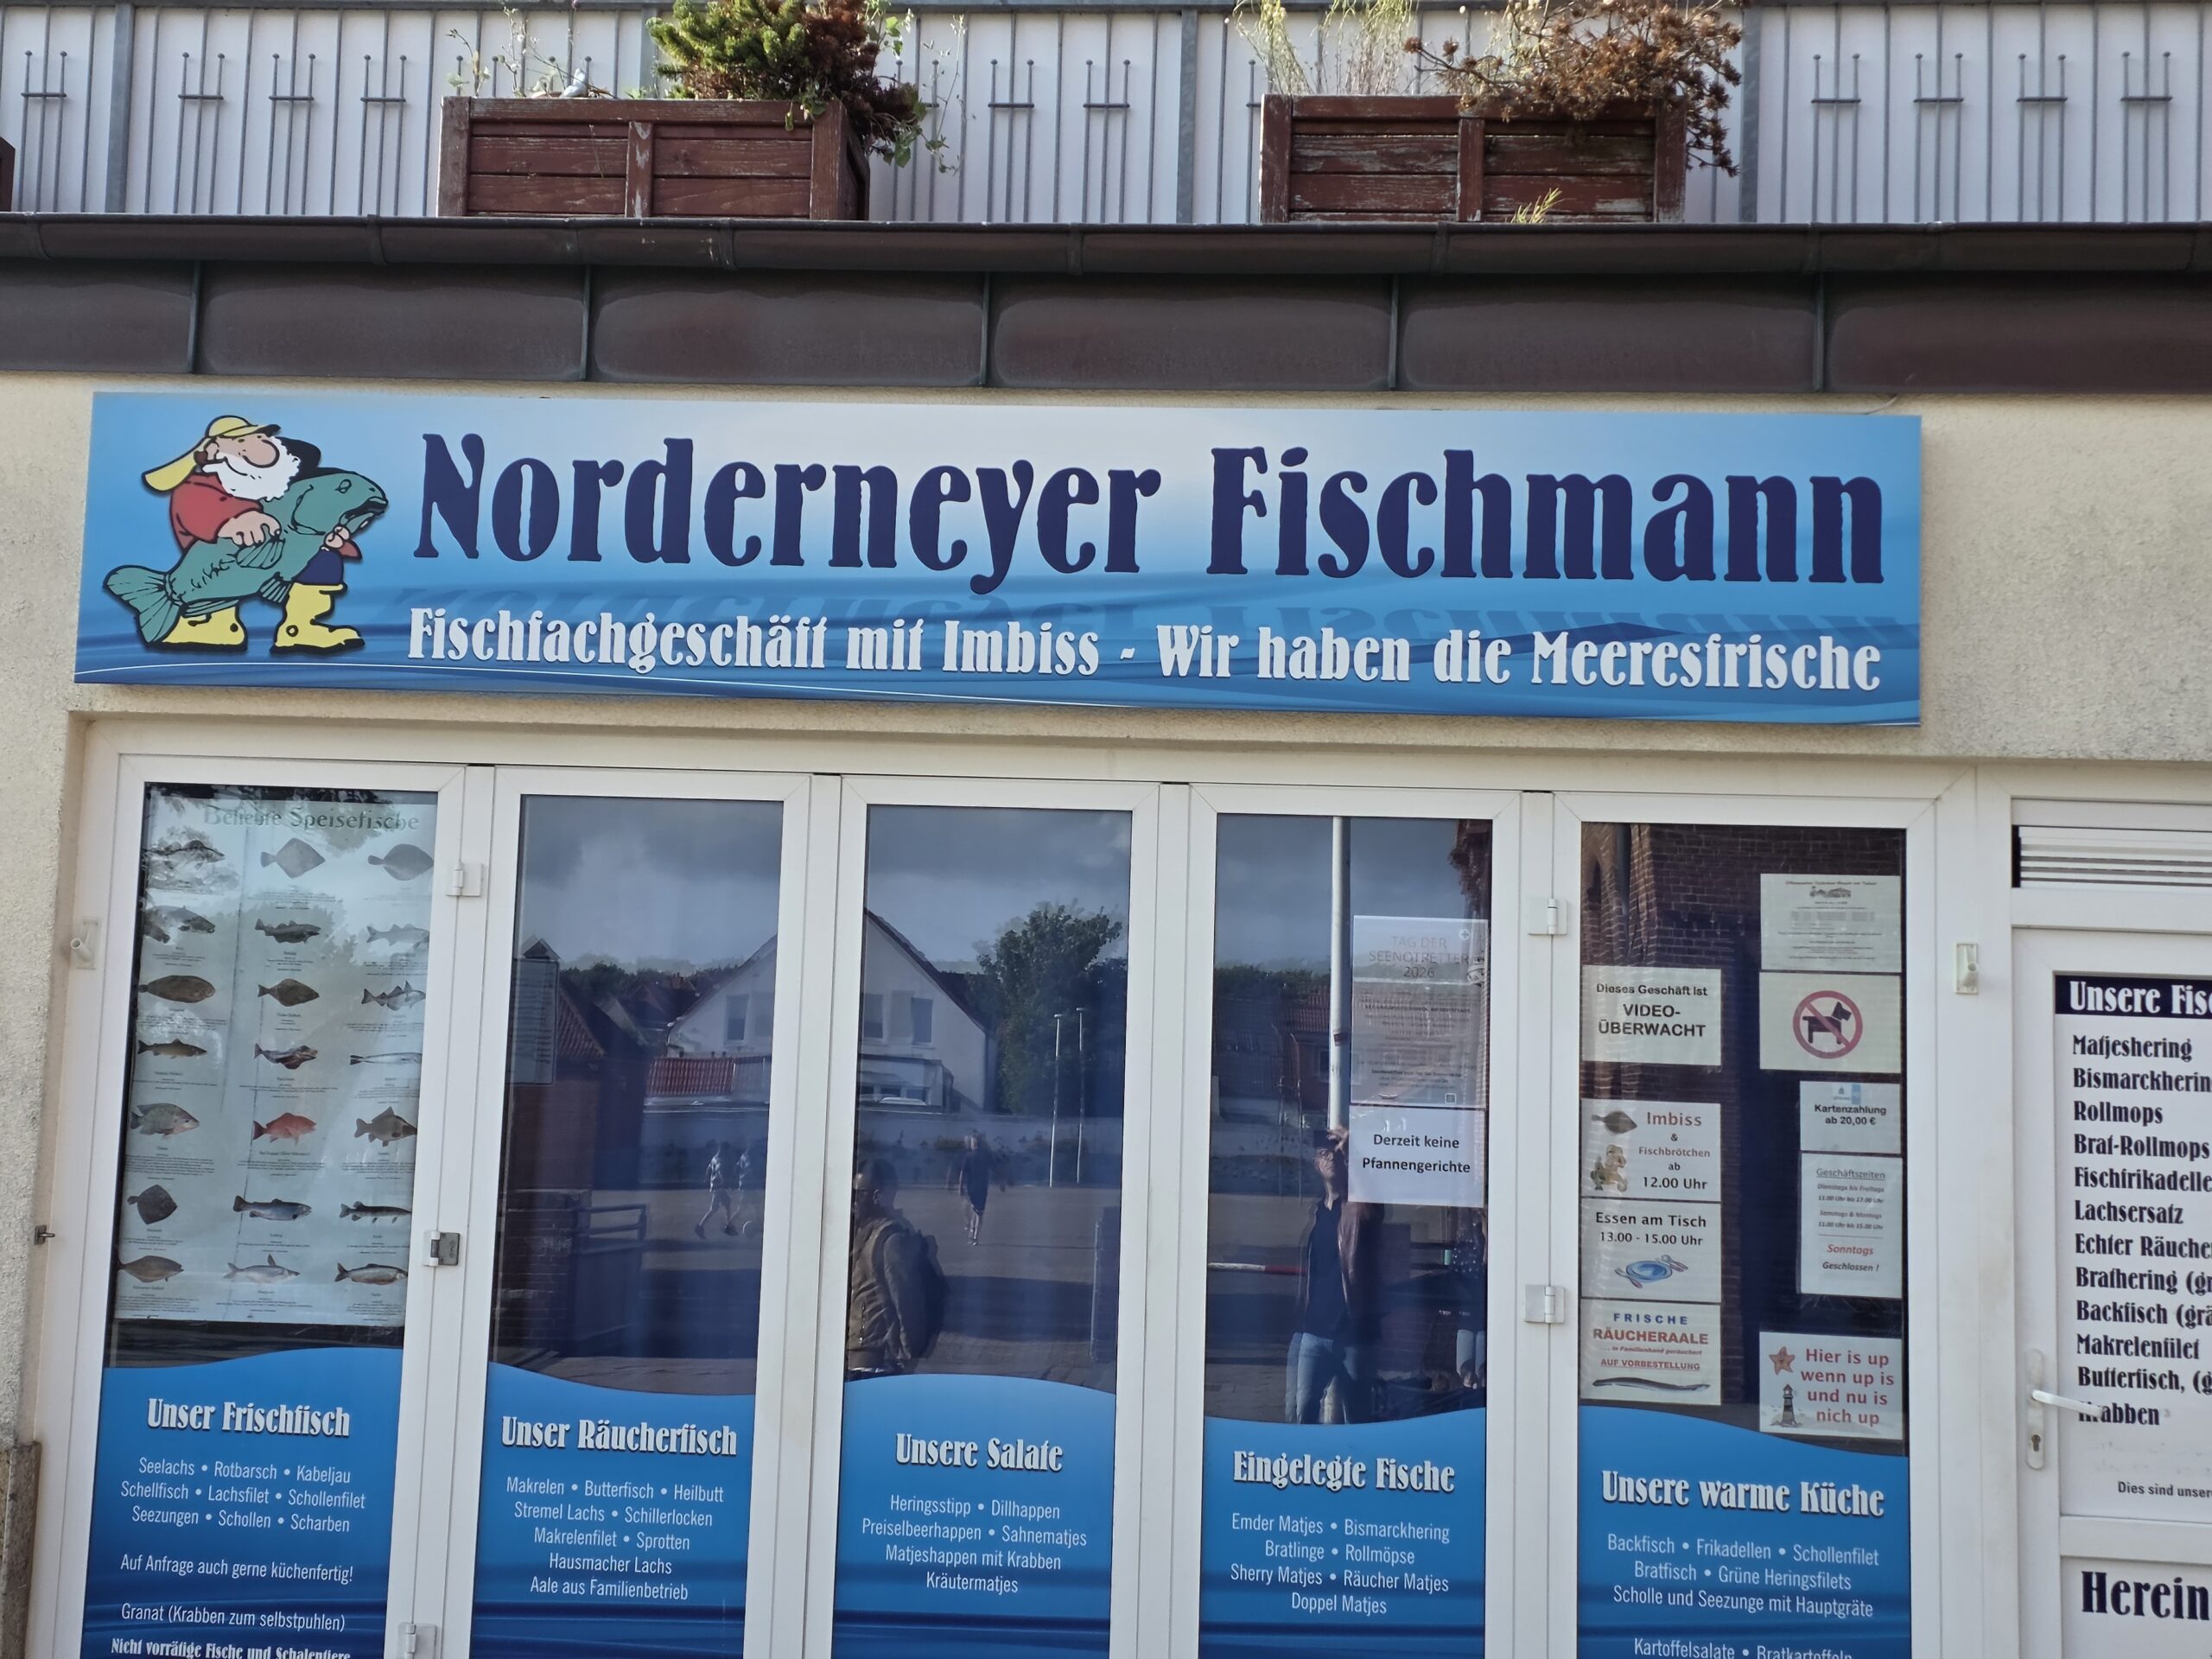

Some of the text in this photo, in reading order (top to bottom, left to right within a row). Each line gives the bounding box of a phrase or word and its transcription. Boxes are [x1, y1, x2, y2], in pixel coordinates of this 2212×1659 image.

[414, 433, 1885, 594] Norderneyer Fischmann
[408, 607, 1881, 691] Fischfachgeschäft mit Imbiss Wir haben die Meeresfrische
[290, 807, 419, 831] Speisefische
[1391, 936, 1446, 948] TAG DER
[1370, 950, 1468, 964] SEENOTRETTER
[1403, 967, 1434, 977] 2026
[1597, 983, 1690, 995] Dieses Geschäft
[2069, 981, 2160, 1013] Unsere
[1624, 1004, 1681, 1017] VIDEO-
[1599, 1020, 1706, 1037] ÜBERWACHT
[2073, 1034, 2192, 1062] Matjeshering
[2074, 1068, 2212, 1092] Bismarckherin
[1647, 1112, 1701, 1126] Imbiss
[1815, 1104, 1886, 1116] Kartenzahlung
[1825, 1116, 1876, 1126] ab 20,00 €
[2074, 1101, 2163, 1126] Rollmops
[1374, 1134, 1459, 1148] Derzeit keine
[1639, 1147, 1710, 1157] Fischbrötchen
[2074, 1134, 2209, 1161] Brat-Rollmops
[1363, 1158, 1471, 1173] Pfannengerichte
[1816, 1168, 1885, 1179] Geschäftszeiten
[1643, 1177, 1707, 1190] 12.00 Uhr
[2074, 1166, 2212, 1192] Fischfrikadelle
[1596, 1212, 1707, 1227] Essen am Tisch
[2074, 1200, 2183, 1224] Lachsersatz
[1600, 1232, 1703, 1245] 13.00 15.00 Uhr
[1827, 1244, 1873, 1255] Sonntags
[2075, 1233, 2212, 1259] Echter Räuche
[1822, 1262, 1873, 1272] Geschlossen
[2075, 1267, 2177, 1294] Brathering
[1613, 1313, 1688, 1325] FRISCHE
[2076, 1300, 2168, 1324] Backfisch
[1593, 1327, 1708, 1344] RÄUCHERAALE
[2076, 1334, 2200, 1360] Makrelenfilet
[1621, 1360, 1700, 1370] VORBESTELLUNG
[1806, 1349, 1889, 1368] Hier is up
[1801, 1371, 1894, 1387] wenn up is
[2077, 1367, 2184, 1393] Butterfisch,
[1808, 1389, 1887, 1405] und nu is
[148, 1398, 351, 1437] Unser Frischfisch
[1816, 1409, 1879, 1427] nich up
[502, 1415, 737, 1456] Unser Räucherfisch
[896, 1433, 1064, 1471] Unsere Salate
[139, 1457, 351, 1486] Seelachs Rotbarsch Kabeljau
[1233, 1451, 1455, 1492] Eingelegte Fische
[121, 1481, 365, 1509] Schellfisch Lachsfilet Schollenfilet
[506, 1476, 724, 1503] Makrelen Butterfisch Heilbutt
[1602, 1470, 1885, 1516] Unsere warme Küche
[2118, 1481, 2173, 1497] Dies sind
[131, 1505, 350, 1533] Seezungen Schollen Scharben
[514, 1501, 713, 1527] Stremel Lachs Schillerlocken
[890, 1495, 1060, 1522] Heringsstipp Dillhappen
[534, 1527, 690, 1552] Makrelenfilet Sprotten
[862, 1518, 1087, 1549] Preiselbeerhappen Sahnematjes
[1231, 1513, 1450, 1544] Emder Matjes Bismarckhering
[886, 1545, 1061, 1570] Matjeshappen mit Krabben
[1265, 1541, 1415, 1567] Bratlinge Rollmöpse
[1608, 1534, 1879, 1567] Backfisch Frikadellen Schollenfilet
[120, 1554, 353, 1585] Auf Anfrage auch gerne küchenfertig!
[550, 1553, 672, 1574] Hausmacher Lachs
[1635, 1560, 1851, 1591] Bratfisch Grüne Heringsfilets
[531, 1576, 688, 1600] Aale aus Familienbetrieb
[926, 1572, 1018, 1596] Kräutermatjes
[1230, 1563, 1449, 1595] Sherry Matjes Räucher Matjes
[1292, 1592, 1387, 1617] Doppel Matjes
[1614, 1585, 1873, 1618] Scholle und Seezunge mit Hauptgräte
[2082, 1571, 2209, 1620] Herein
[122, 1603, 345, 1632] Granat (Krabben zum selbstpuhlen)
[111, 1637, 270, 1659] Nicht vorrätige Fische und
[1635, 1637, 1734, 1659] Kartoffelsalate
